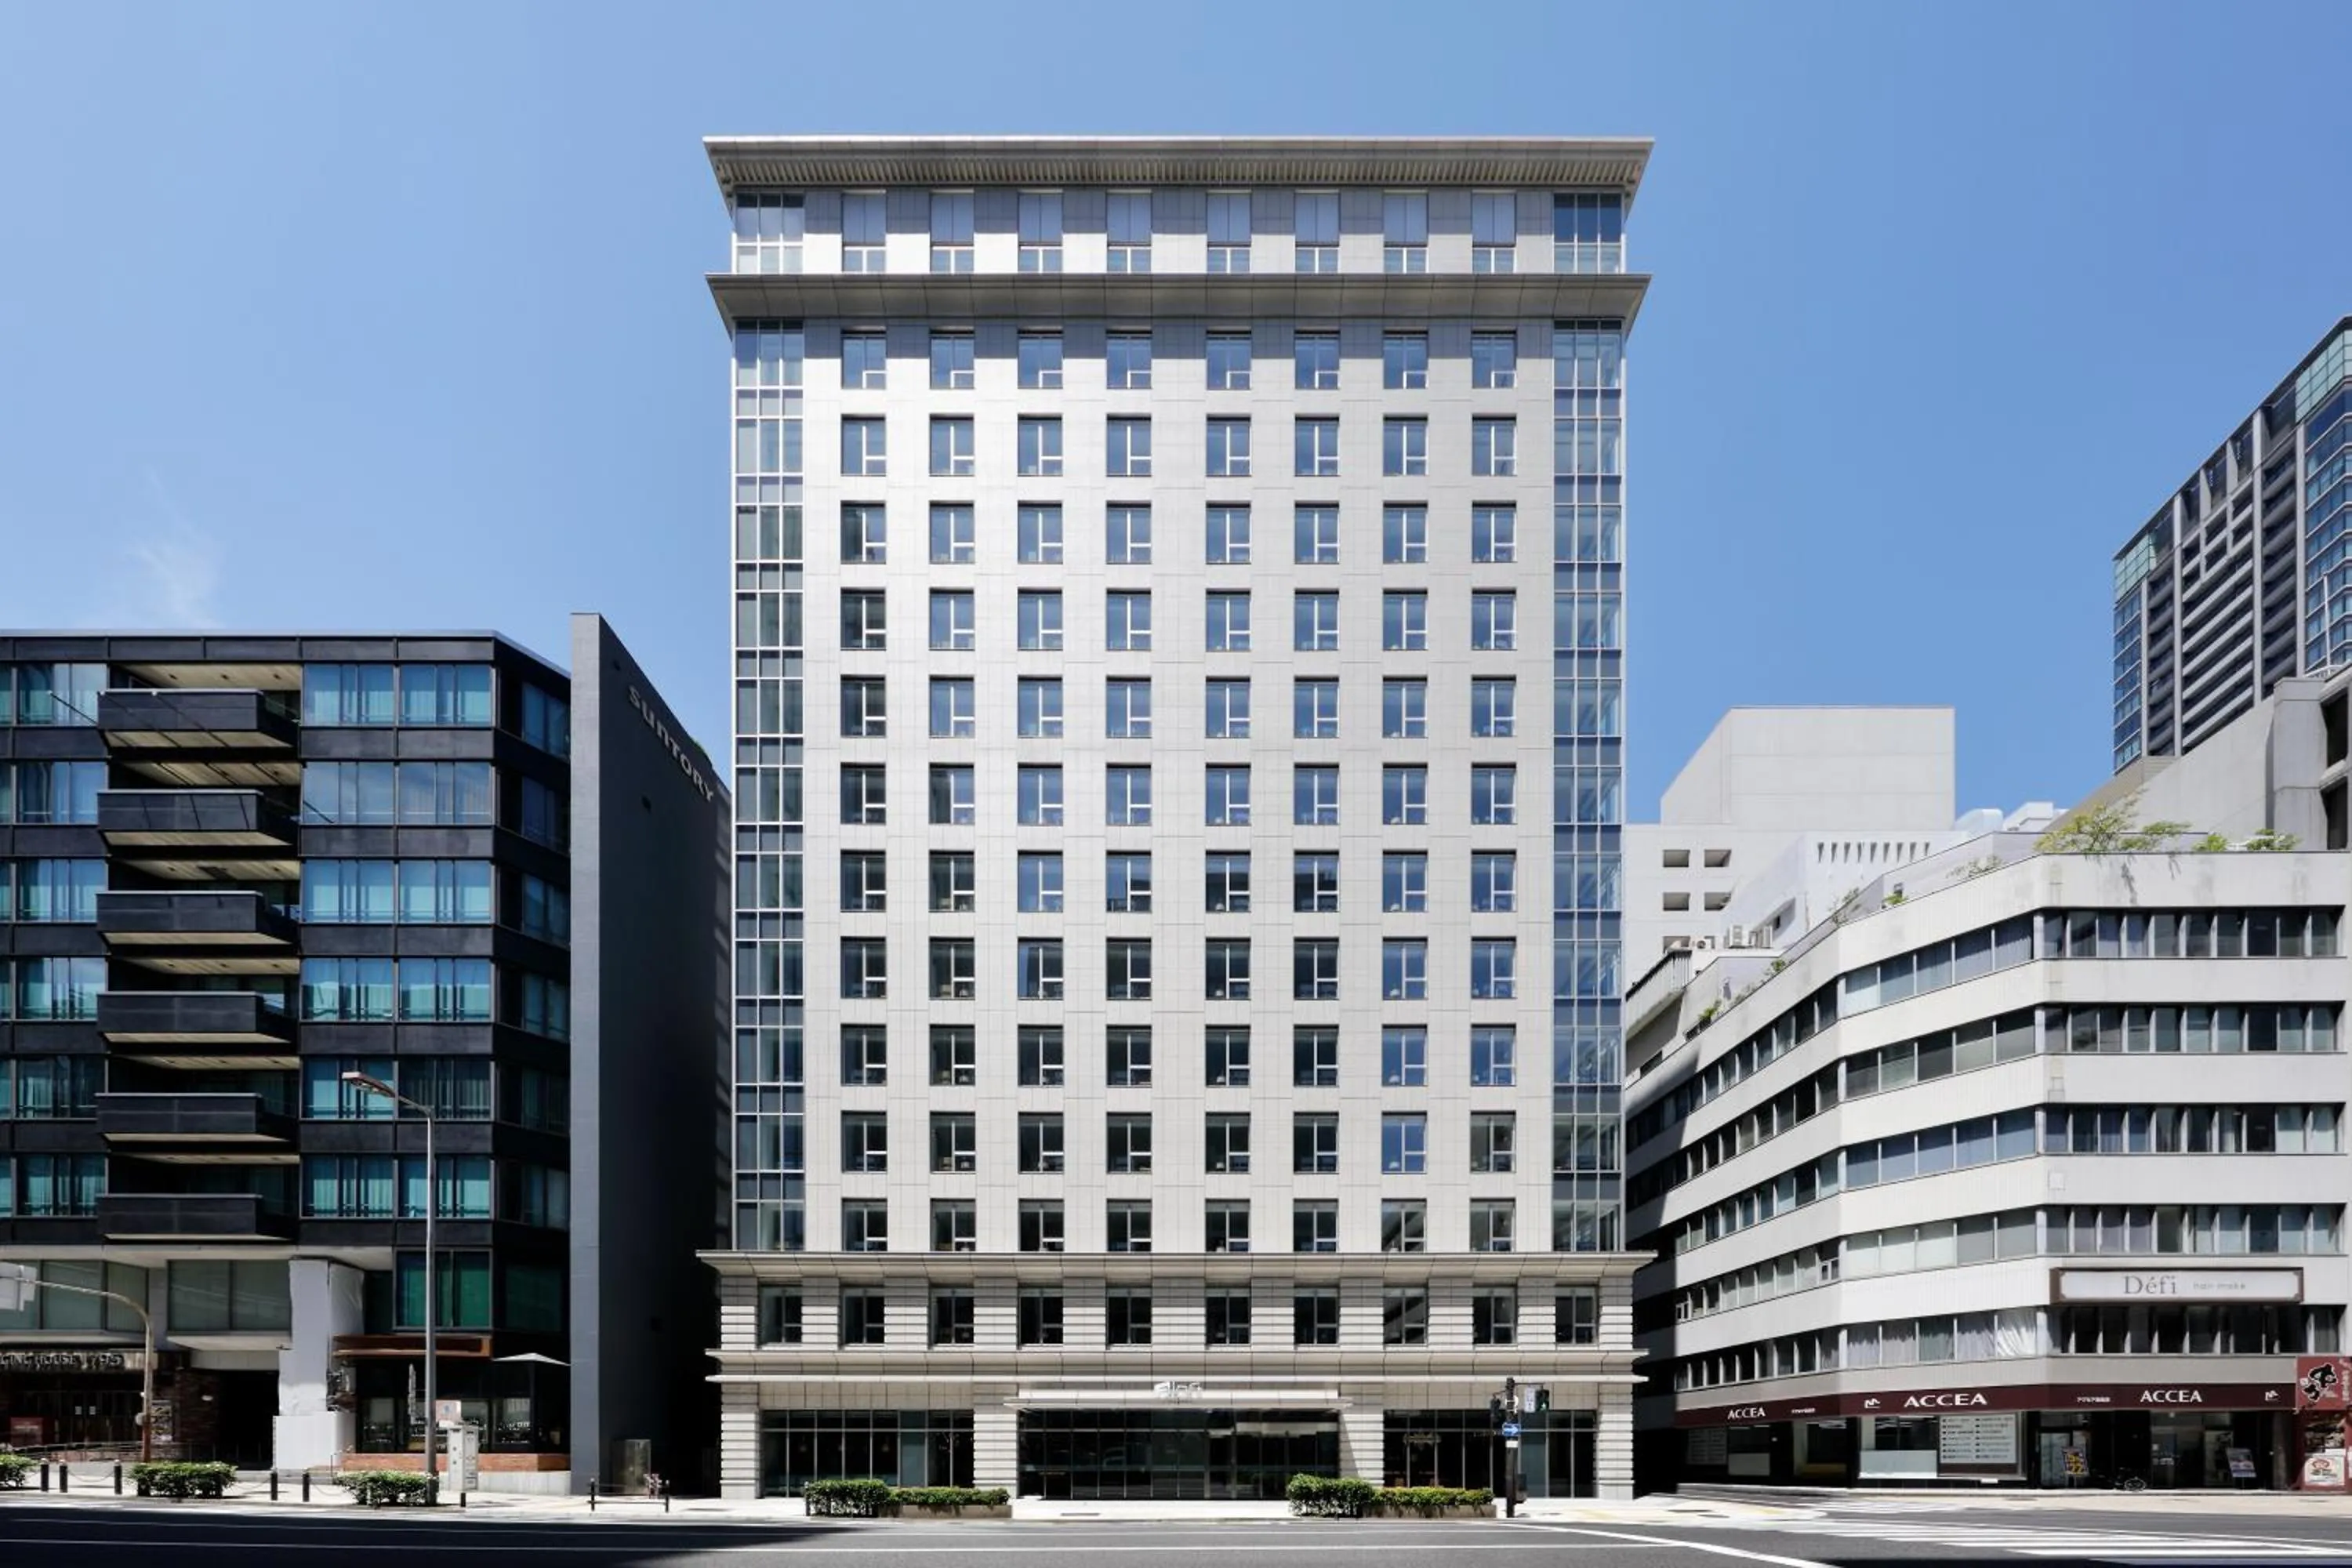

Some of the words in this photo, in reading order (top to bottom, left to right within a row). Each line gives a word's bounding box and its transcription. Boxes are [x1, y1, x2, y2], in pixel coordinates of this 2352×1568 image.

[630, 684, 713, 802] SUNTORY
[2124, 1275, 2177, 1294] Défi
[1904, 1393, 1987, 1408] ACCEA
[2140, 1390, 2202, 1403] ACCEA
[1728, 1407, 1766, 1420] ACCEA
